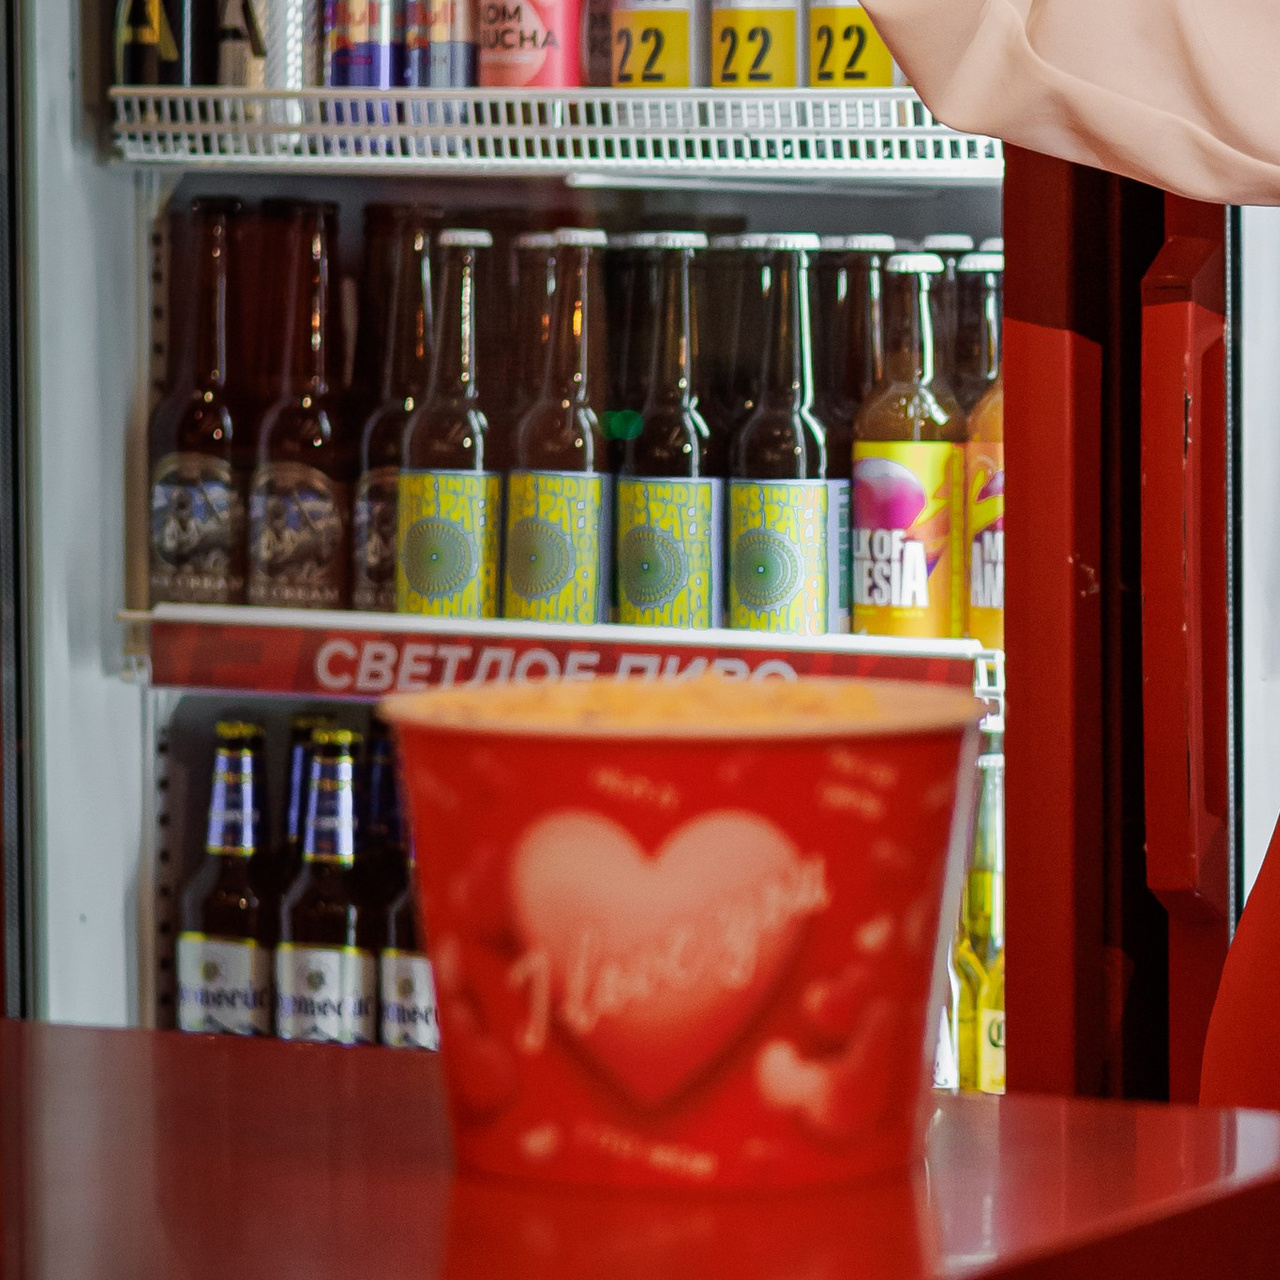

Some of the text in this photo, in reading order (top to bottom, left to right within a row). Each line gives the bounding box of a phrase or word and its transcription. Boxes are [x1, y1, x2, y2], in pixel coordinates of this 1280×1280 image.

[484, 2, 523, 24] OM
[617, 26, 666, 83] 22
[720, 26, 773, 82] 22
[816, 24, 867, 81] 22
[872, 528, 906, 560] OF
[313, 638, 601, 694] СВЕТЛОЕ
